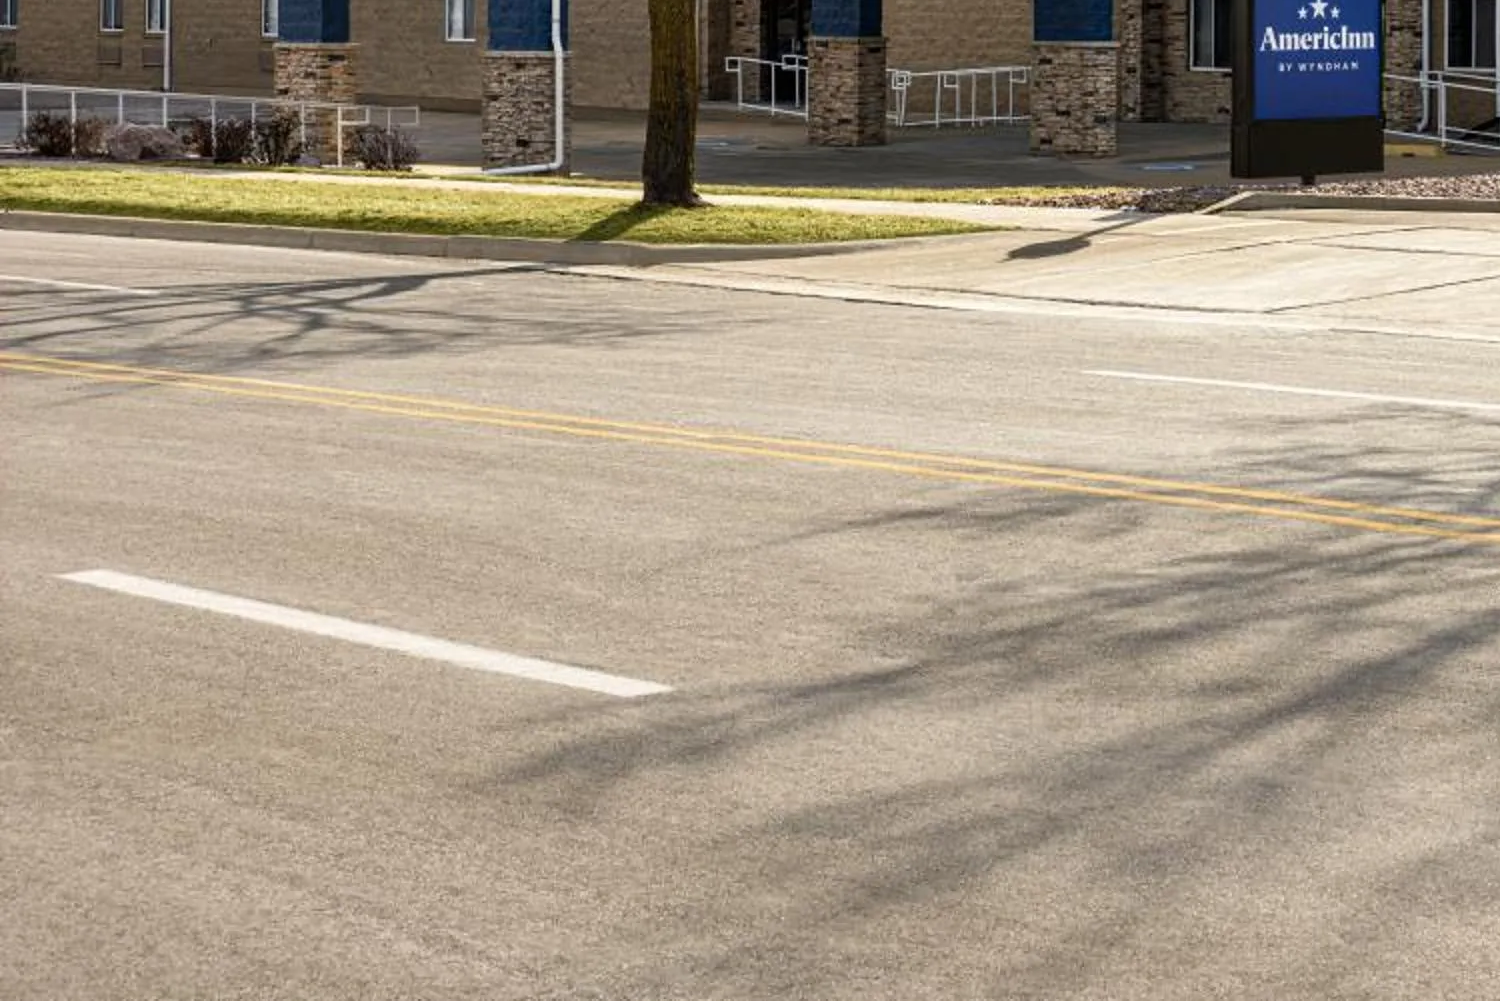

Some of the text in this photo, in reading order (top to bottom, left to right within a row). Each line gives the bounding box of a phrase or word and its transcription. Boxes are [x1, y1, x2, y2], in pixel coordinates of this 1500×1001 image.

[1260, 25, 1375, 51] AmericInn
[1278, 61, 1359, 72] BY WYNDHAM
